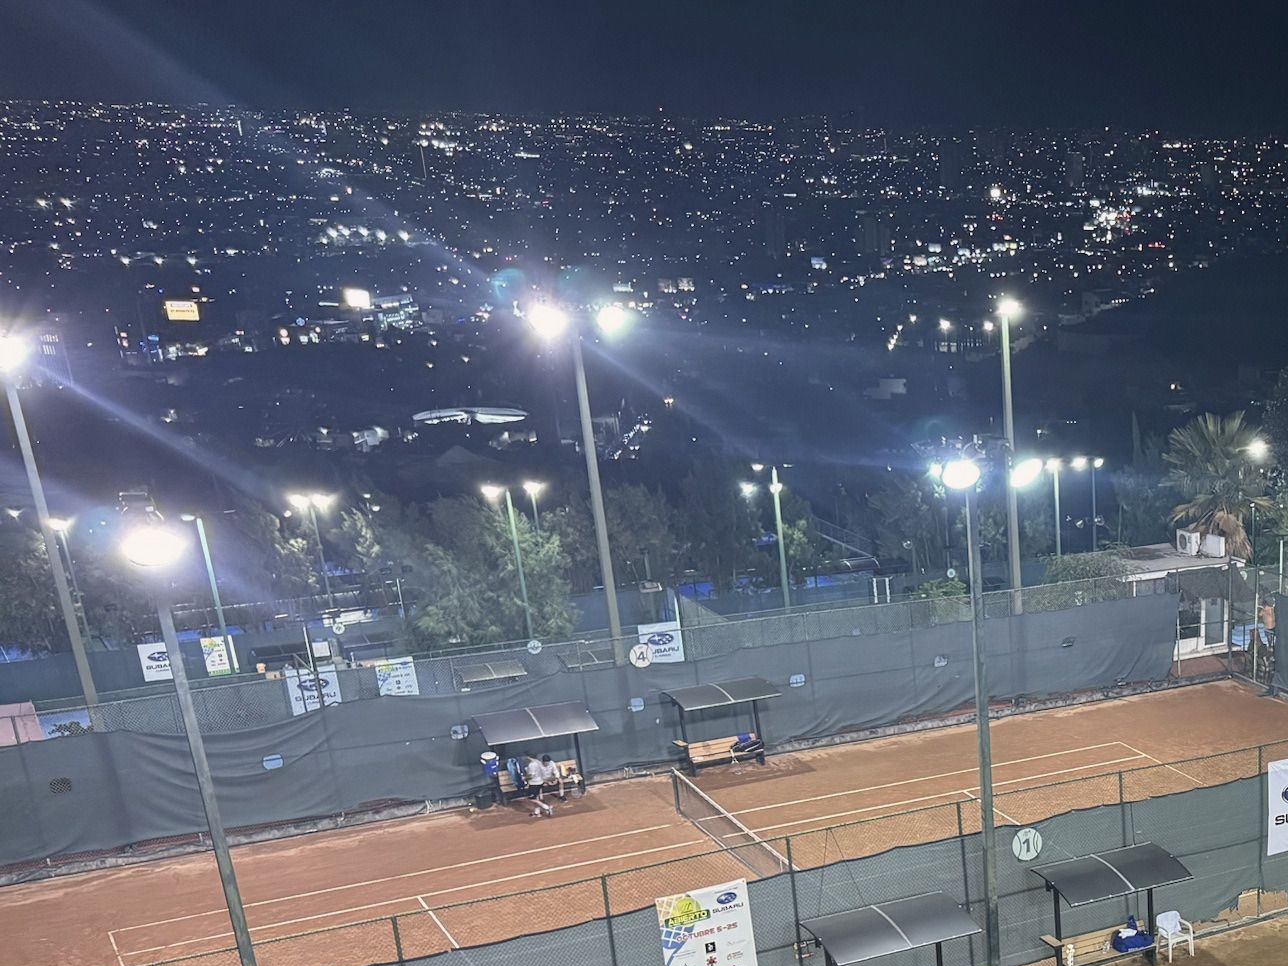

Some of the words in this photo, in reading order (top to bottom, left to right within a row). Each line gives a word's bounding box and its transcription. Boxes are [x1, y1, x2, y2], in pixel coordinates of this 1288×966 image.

[637, 651, 646, 662] 4
[652, 646, 679, 655] UBARU
[1022, 838, 1030, 853] 1
[712, 903, 744, 914] SUBARU
[668, 910, 708, 926] ABIERTO
[676, 927, 715, 944] OCTUBRE
[717, 921, 738, 934] 5-25
